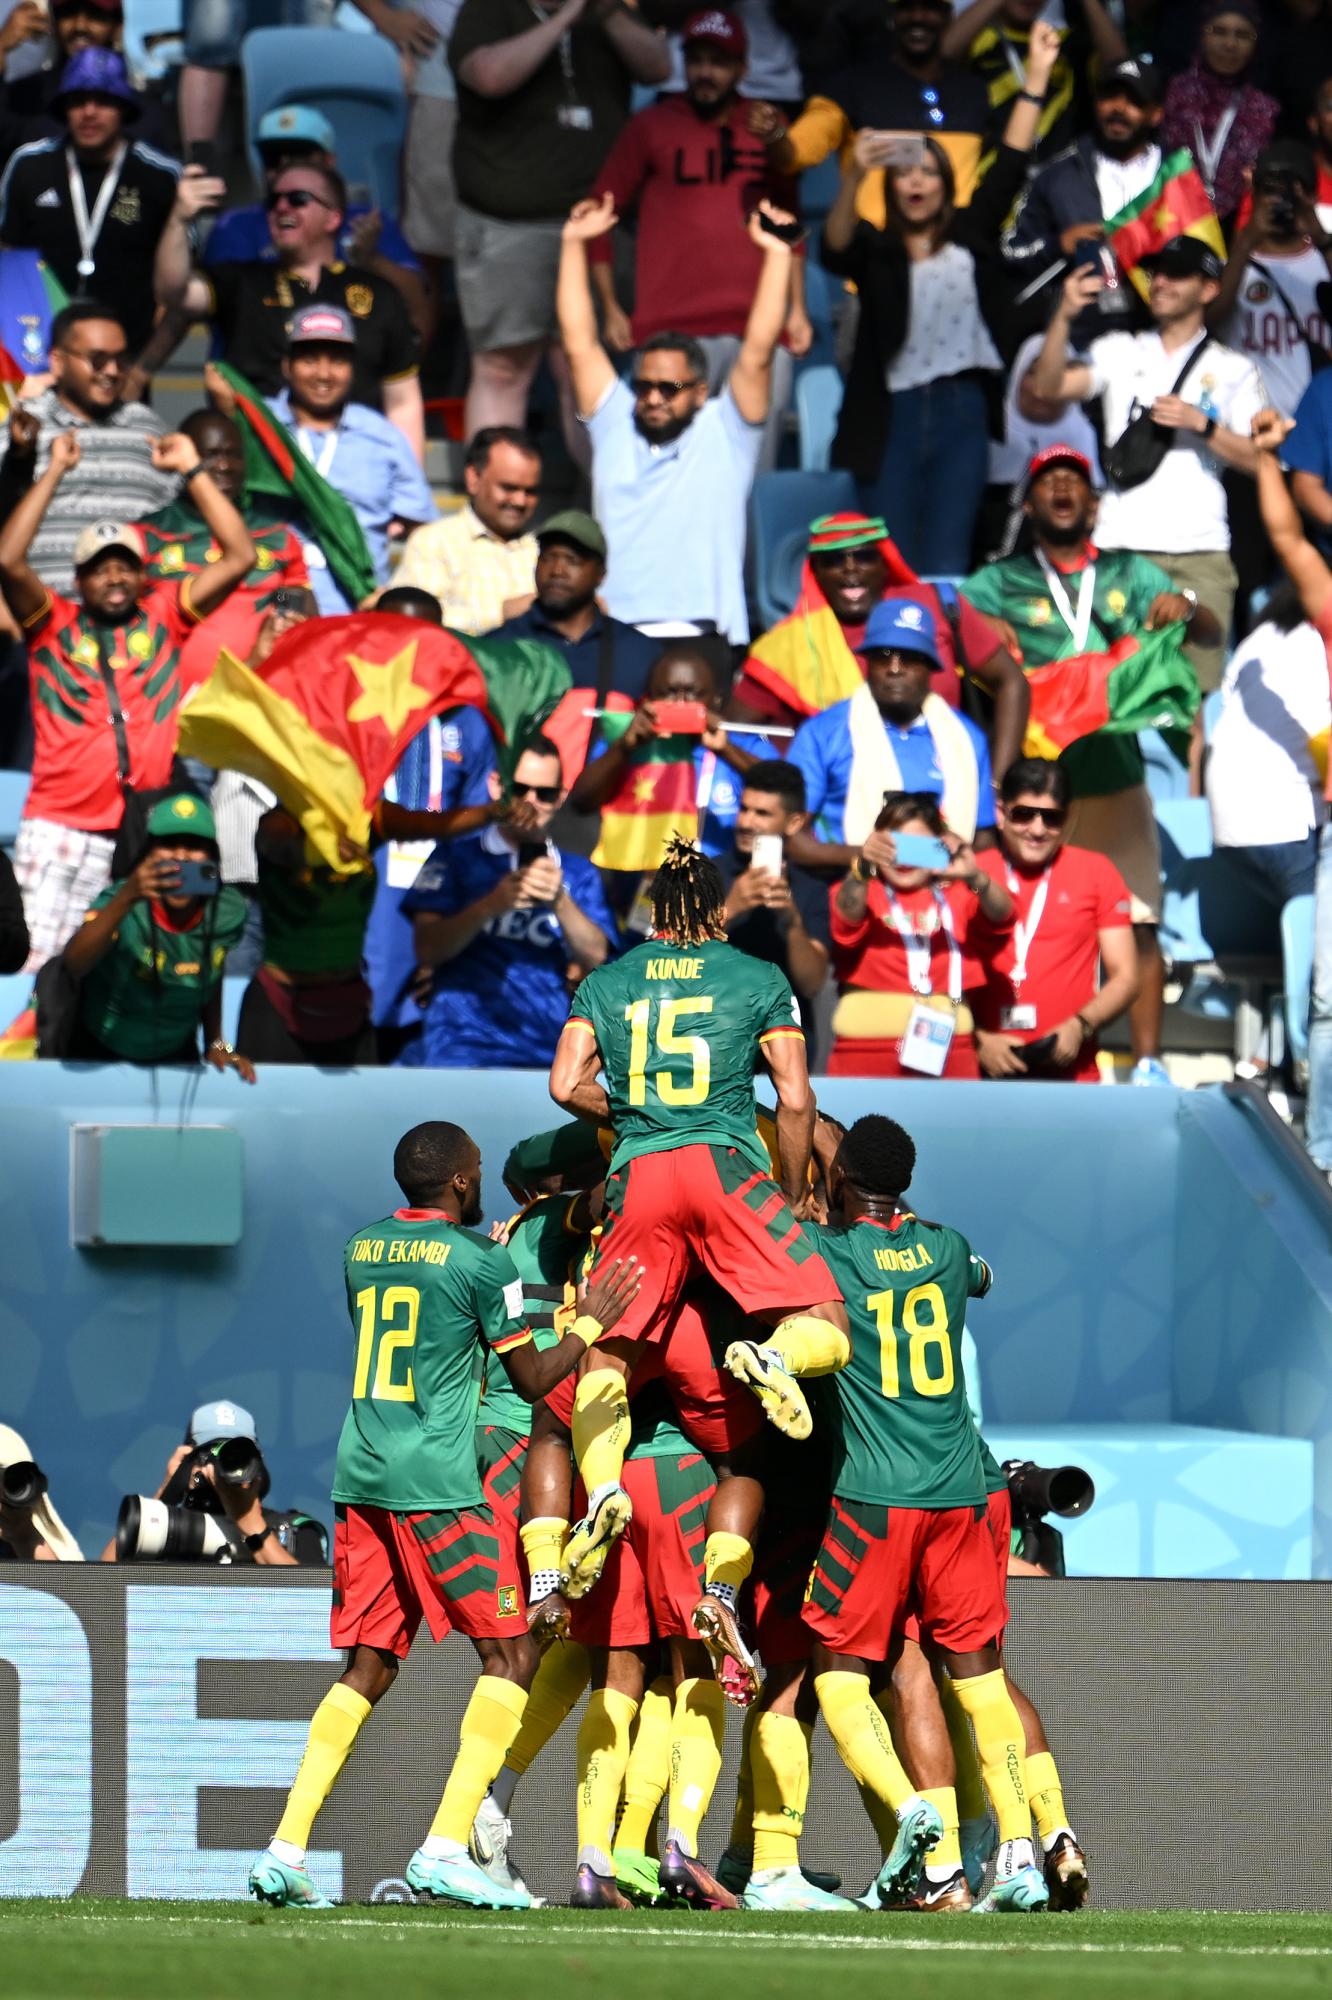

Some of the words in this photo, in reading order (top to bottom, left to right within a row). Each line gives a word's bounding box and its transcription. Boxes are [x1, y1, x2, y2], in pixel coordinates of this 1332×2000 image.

[645, 957, 705, 980] KUNDE
[624, 996, 713, 1106] 15
[351, 1239, 385, 1262] TOKO
[388, 1240, 452, 1267] EKAMBI
[352, 1285, 421, 1402] 12
[866, 1282, 954, 1398] 18
[1006, 1744, 1026, 1805] CAMEROUN
